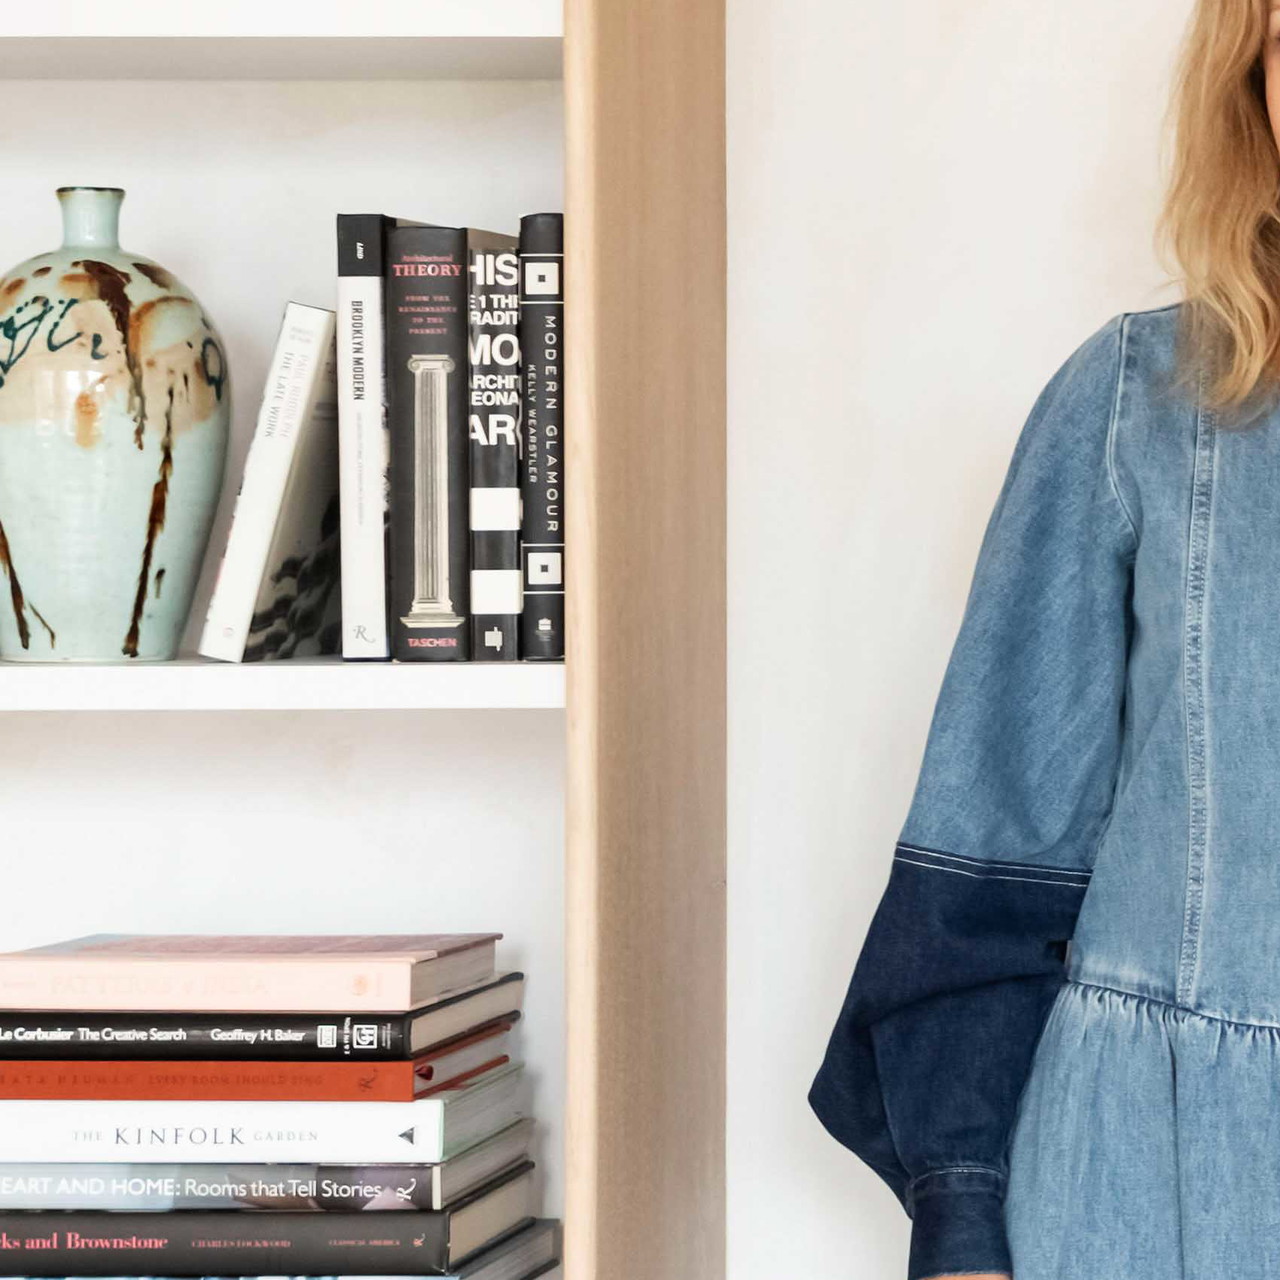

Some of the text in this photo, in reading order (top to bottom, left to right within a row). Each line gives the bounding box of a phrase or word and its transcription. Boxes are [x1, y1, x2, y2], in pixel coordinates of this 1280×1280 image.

[392, 264, 463, 276] THEORY
[351, 300, 364, 354] BROOKLYN
[352, 356, 365, 401] MODERN
[527, 364, 539, 484] KELLY WEARSTLER
[544, 315, 559, 532] MODERN GLAMOUR
[407, 637, 457, 648] TASCHEN
[14, 1027, 73, 1041] Corbusier
[77, 1028, 100, 1040] The
[101, 1027, 147, 1041] Creative
[149, 1028, 187, 1041] Search
[210, 1028, 257, 1044] Geoffrey
[274, 1028, 306, 1042] Baker
[72, 1127, 318, 1145] THE KINFOLK GARDEN
[56, 1177, 104, 1195] AND
[112, 1177, 181, 1196] HOME:
[185, 1178, 246, 1197] Rooms
[251, 1178, 285, 1198] that
[289, 1179, 317, 1198] Tell
[321, 1179, 382, 1199] Stories
[25, 1232, 168, 1250] and Brownstone
